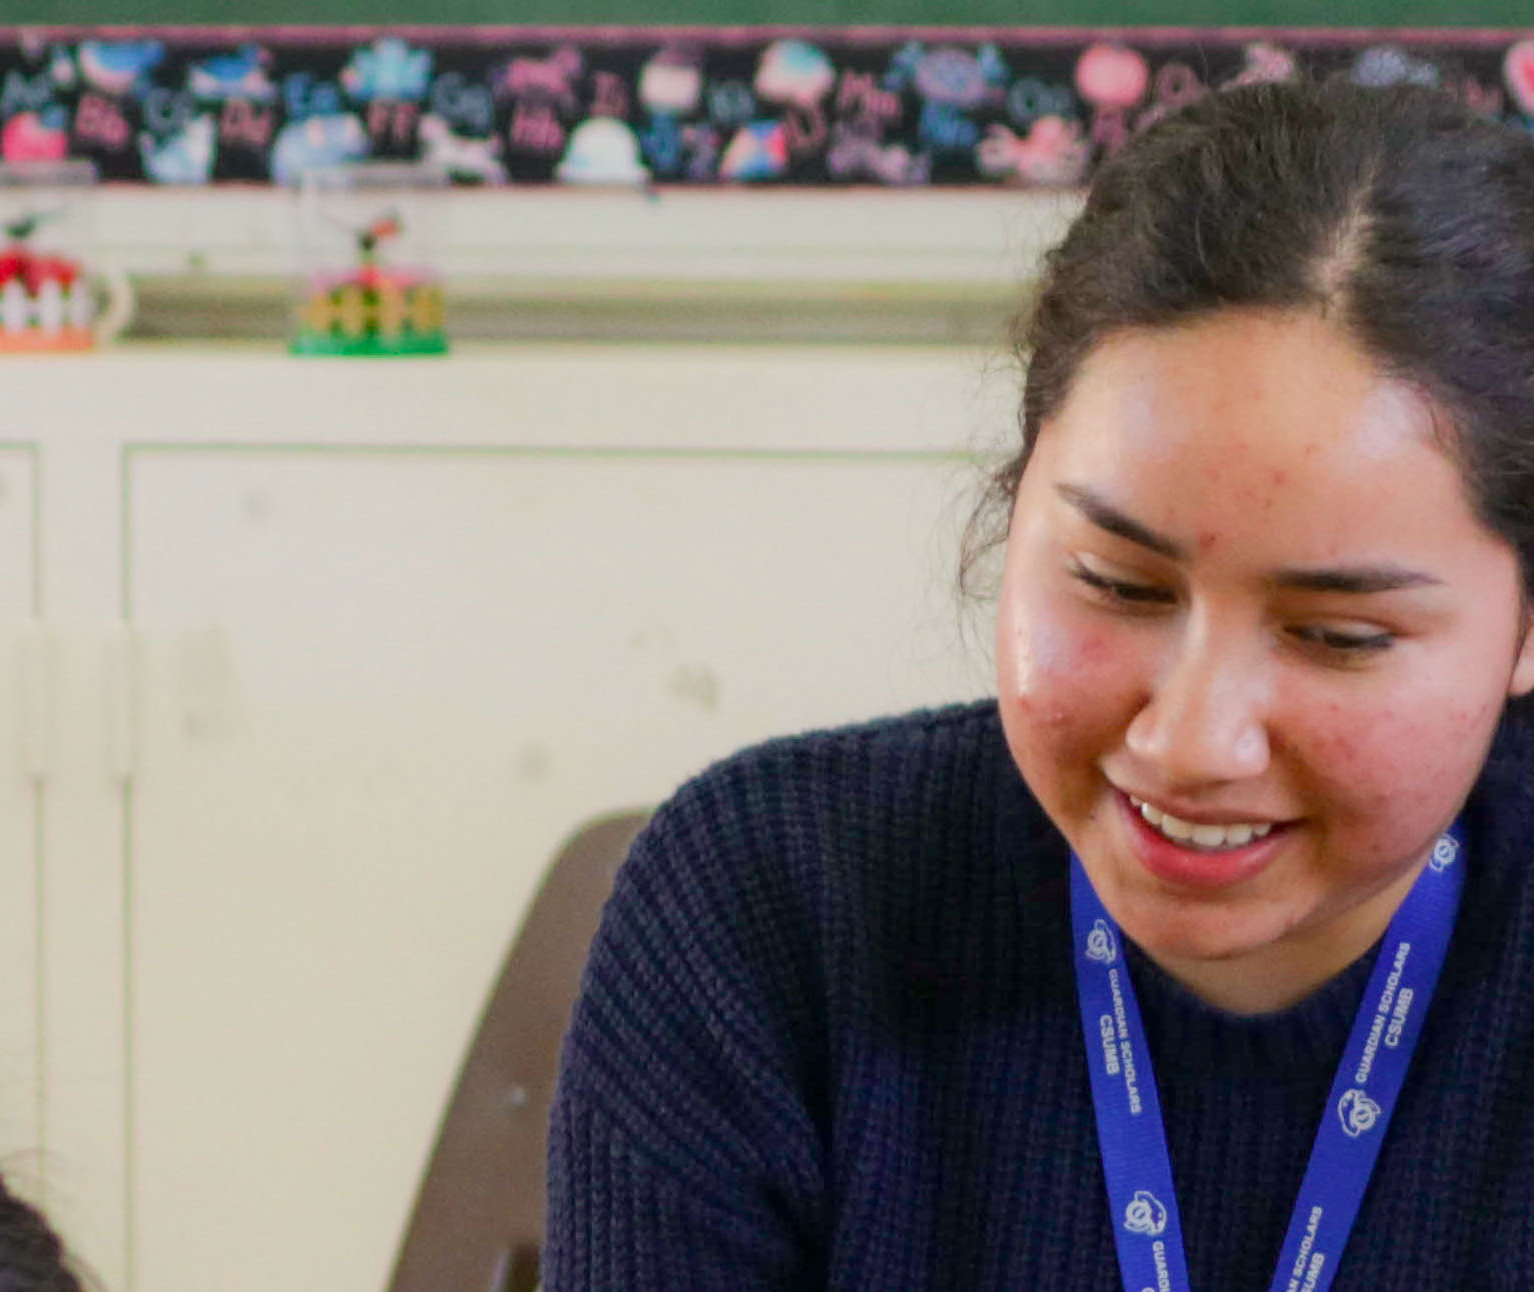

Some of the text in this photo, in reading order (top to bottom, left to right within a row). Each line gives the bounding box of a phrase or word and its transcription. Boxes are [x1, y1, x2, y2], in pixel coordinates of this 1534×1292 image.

[1099, 1014, 1120, 1075] CSUMB
[1108, 968, 1142, 1115] GUARDIAN SCHOLARS
[1355, 942, 1411, 1083] GUARDIAN SCHOLARS
[1384, 987, 1414, 1047] CSUMB
[1292, 1206, 1323, 1278] SCHOLARS
